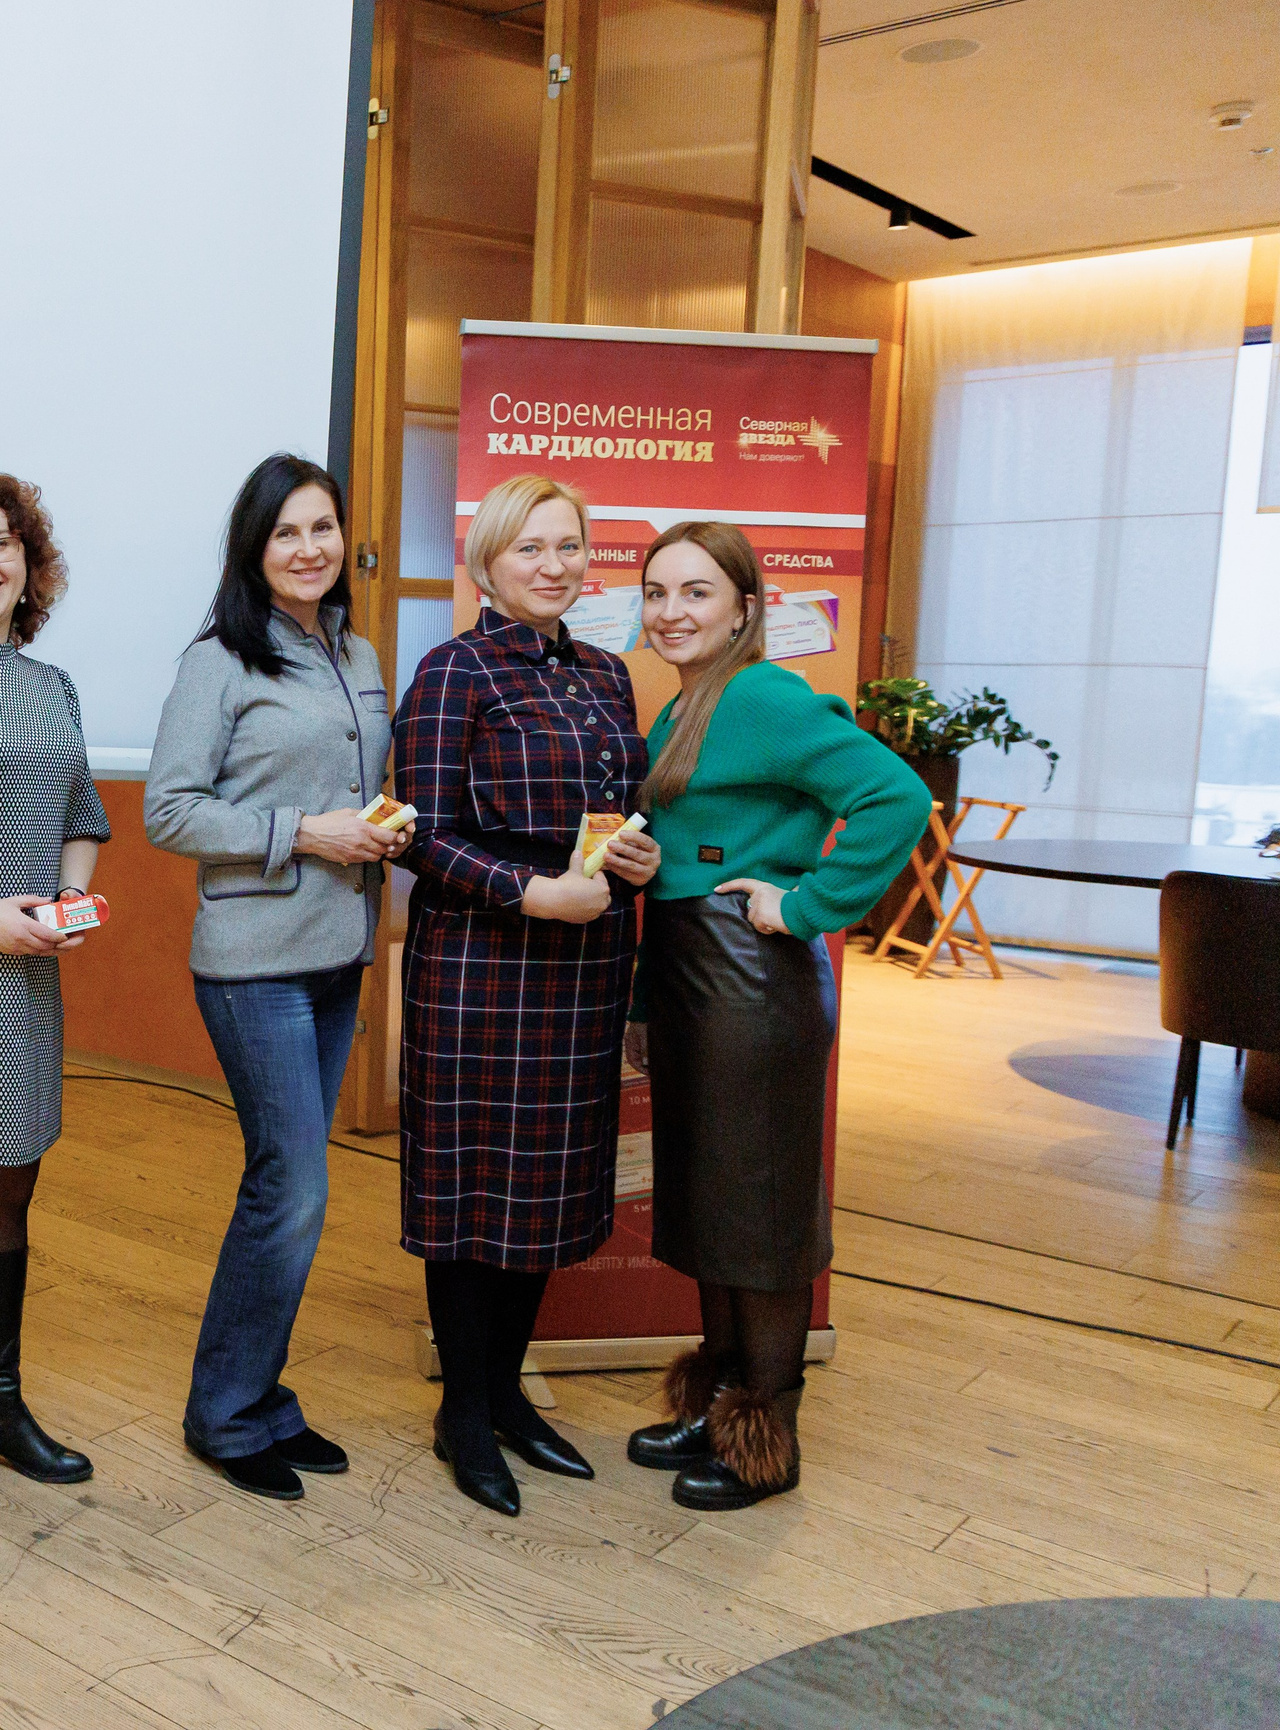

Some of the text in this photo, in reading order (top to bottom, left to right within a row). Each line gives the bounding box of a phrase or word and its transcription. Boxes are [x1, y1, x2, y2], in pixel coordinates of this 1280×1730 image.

[489, 392, 712, 433] Современная
[739, 416, 808, 434] Северная
[739, 433, 796, 446] ЗВЕЗДА
[487, 432, 715, 462] КАРДИОЛОГИЯ
[739, 452, 758, 460] Нам
[589, 548, 637, 562] АННЫЕ
[762, 553, 834, 568] СРЕДСТВА
[629, 1095, 641, 1105] 10
